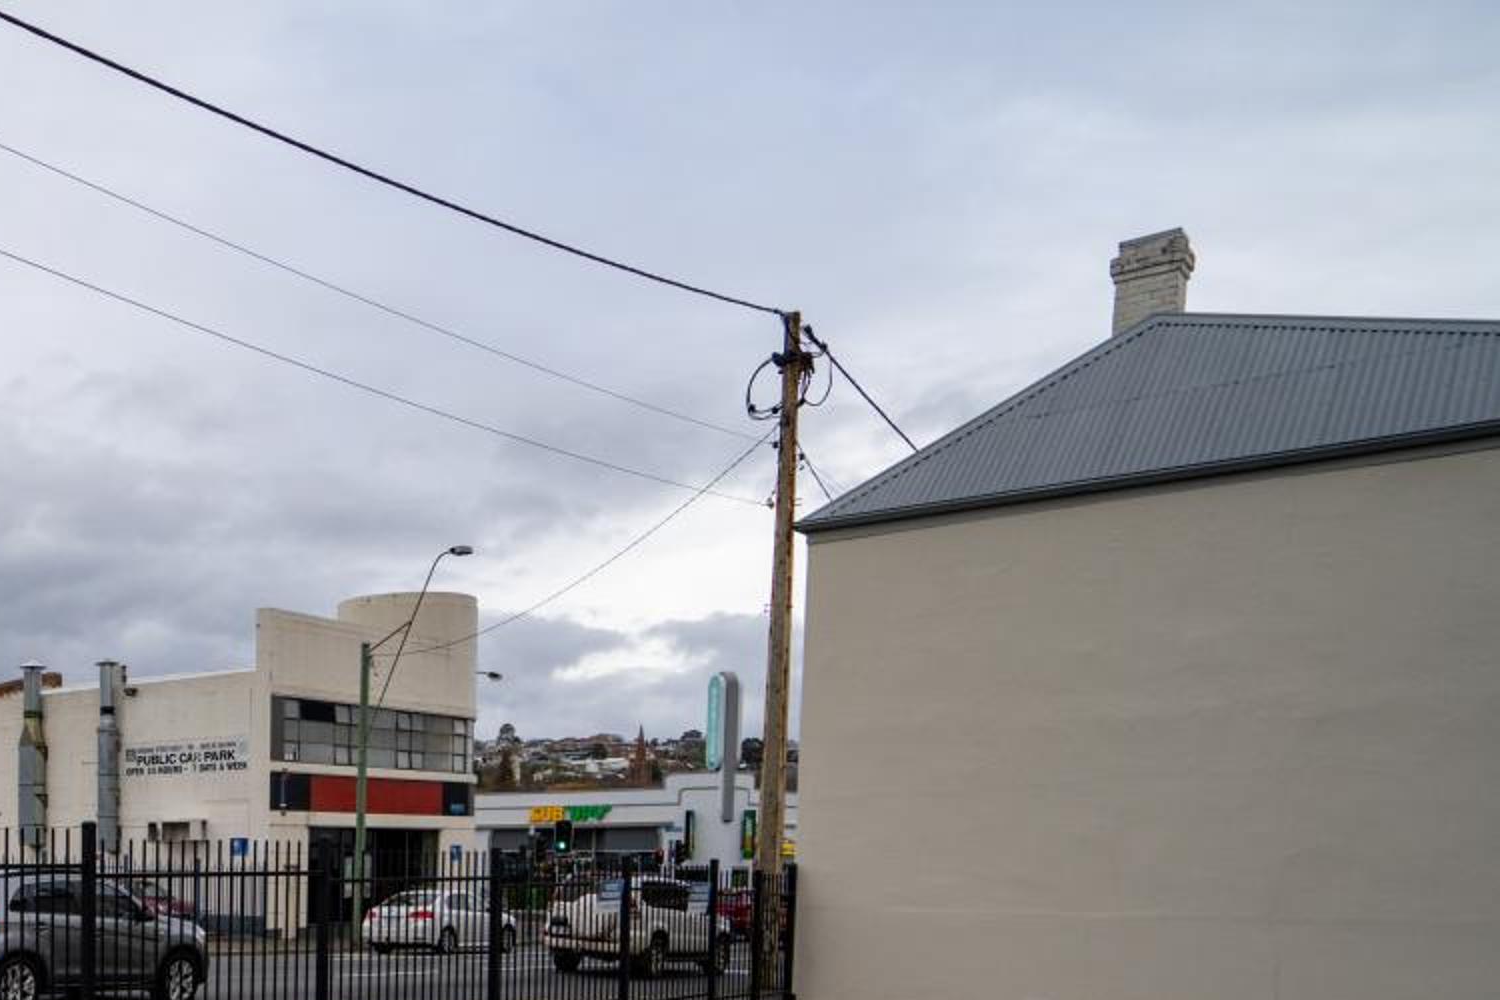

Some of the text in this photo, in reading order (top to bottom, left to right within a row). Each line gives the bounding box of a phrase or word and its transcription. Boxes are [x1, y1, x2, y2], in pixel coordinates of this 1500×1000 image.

[137, 750, 235, 766] PUBLIC CAR PARK
